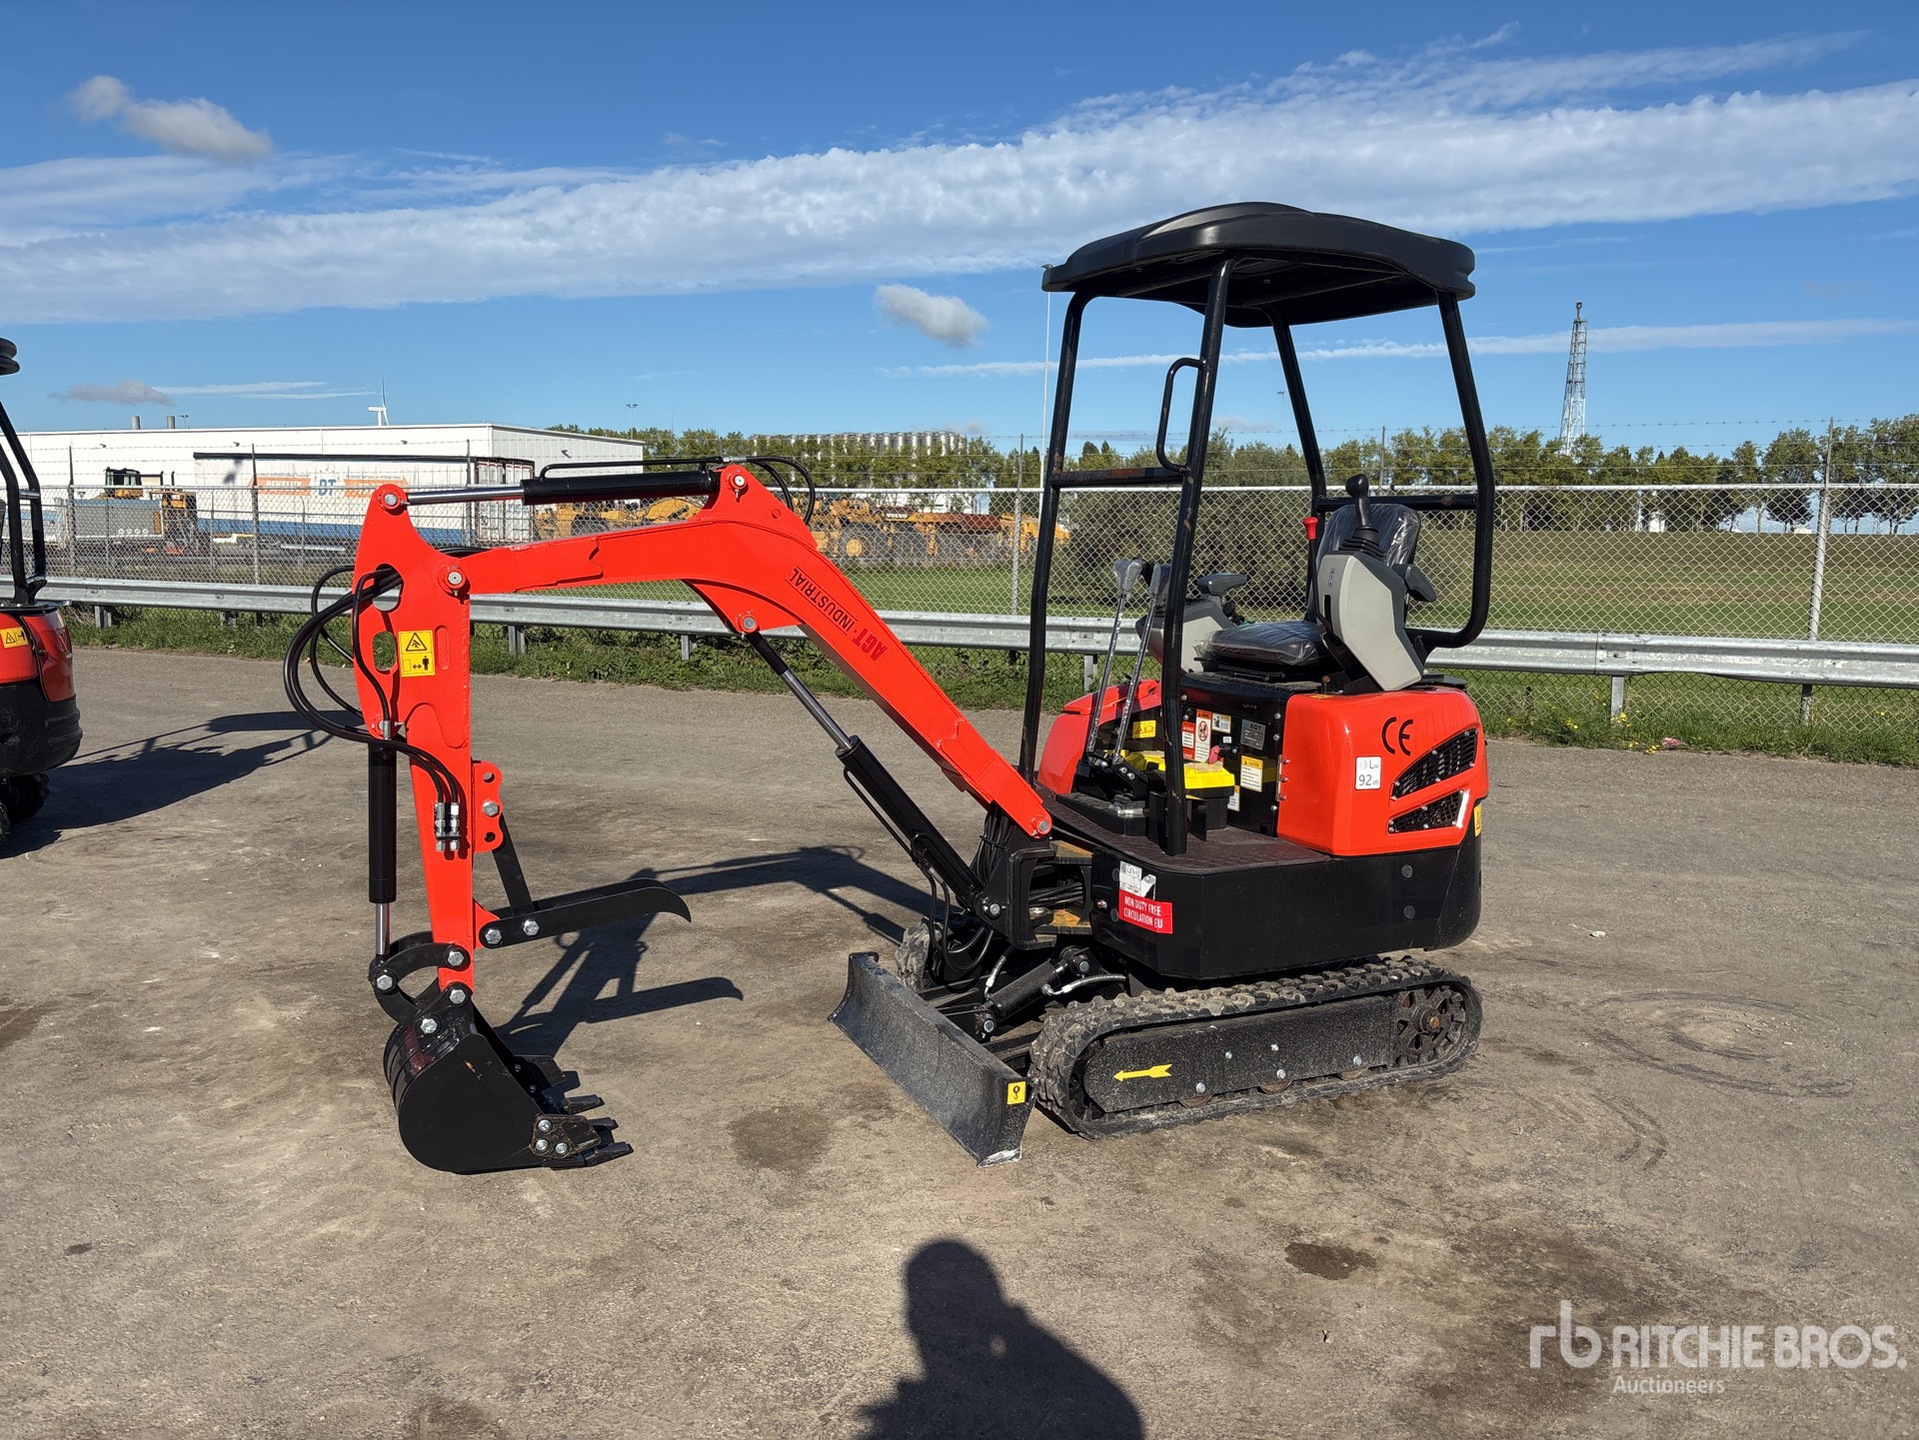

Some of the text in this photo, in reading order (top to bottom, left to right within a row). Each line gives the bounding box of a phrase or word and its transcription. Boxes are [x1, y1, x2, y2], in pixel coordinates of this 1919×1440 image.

[789, 568, 888, 661] AGT INDUSTRIAL
[1358, 774, 1373, 787] 92
[1148, 903, 1161, 917] FREE
[1154, 917, 1164, 929] EU
